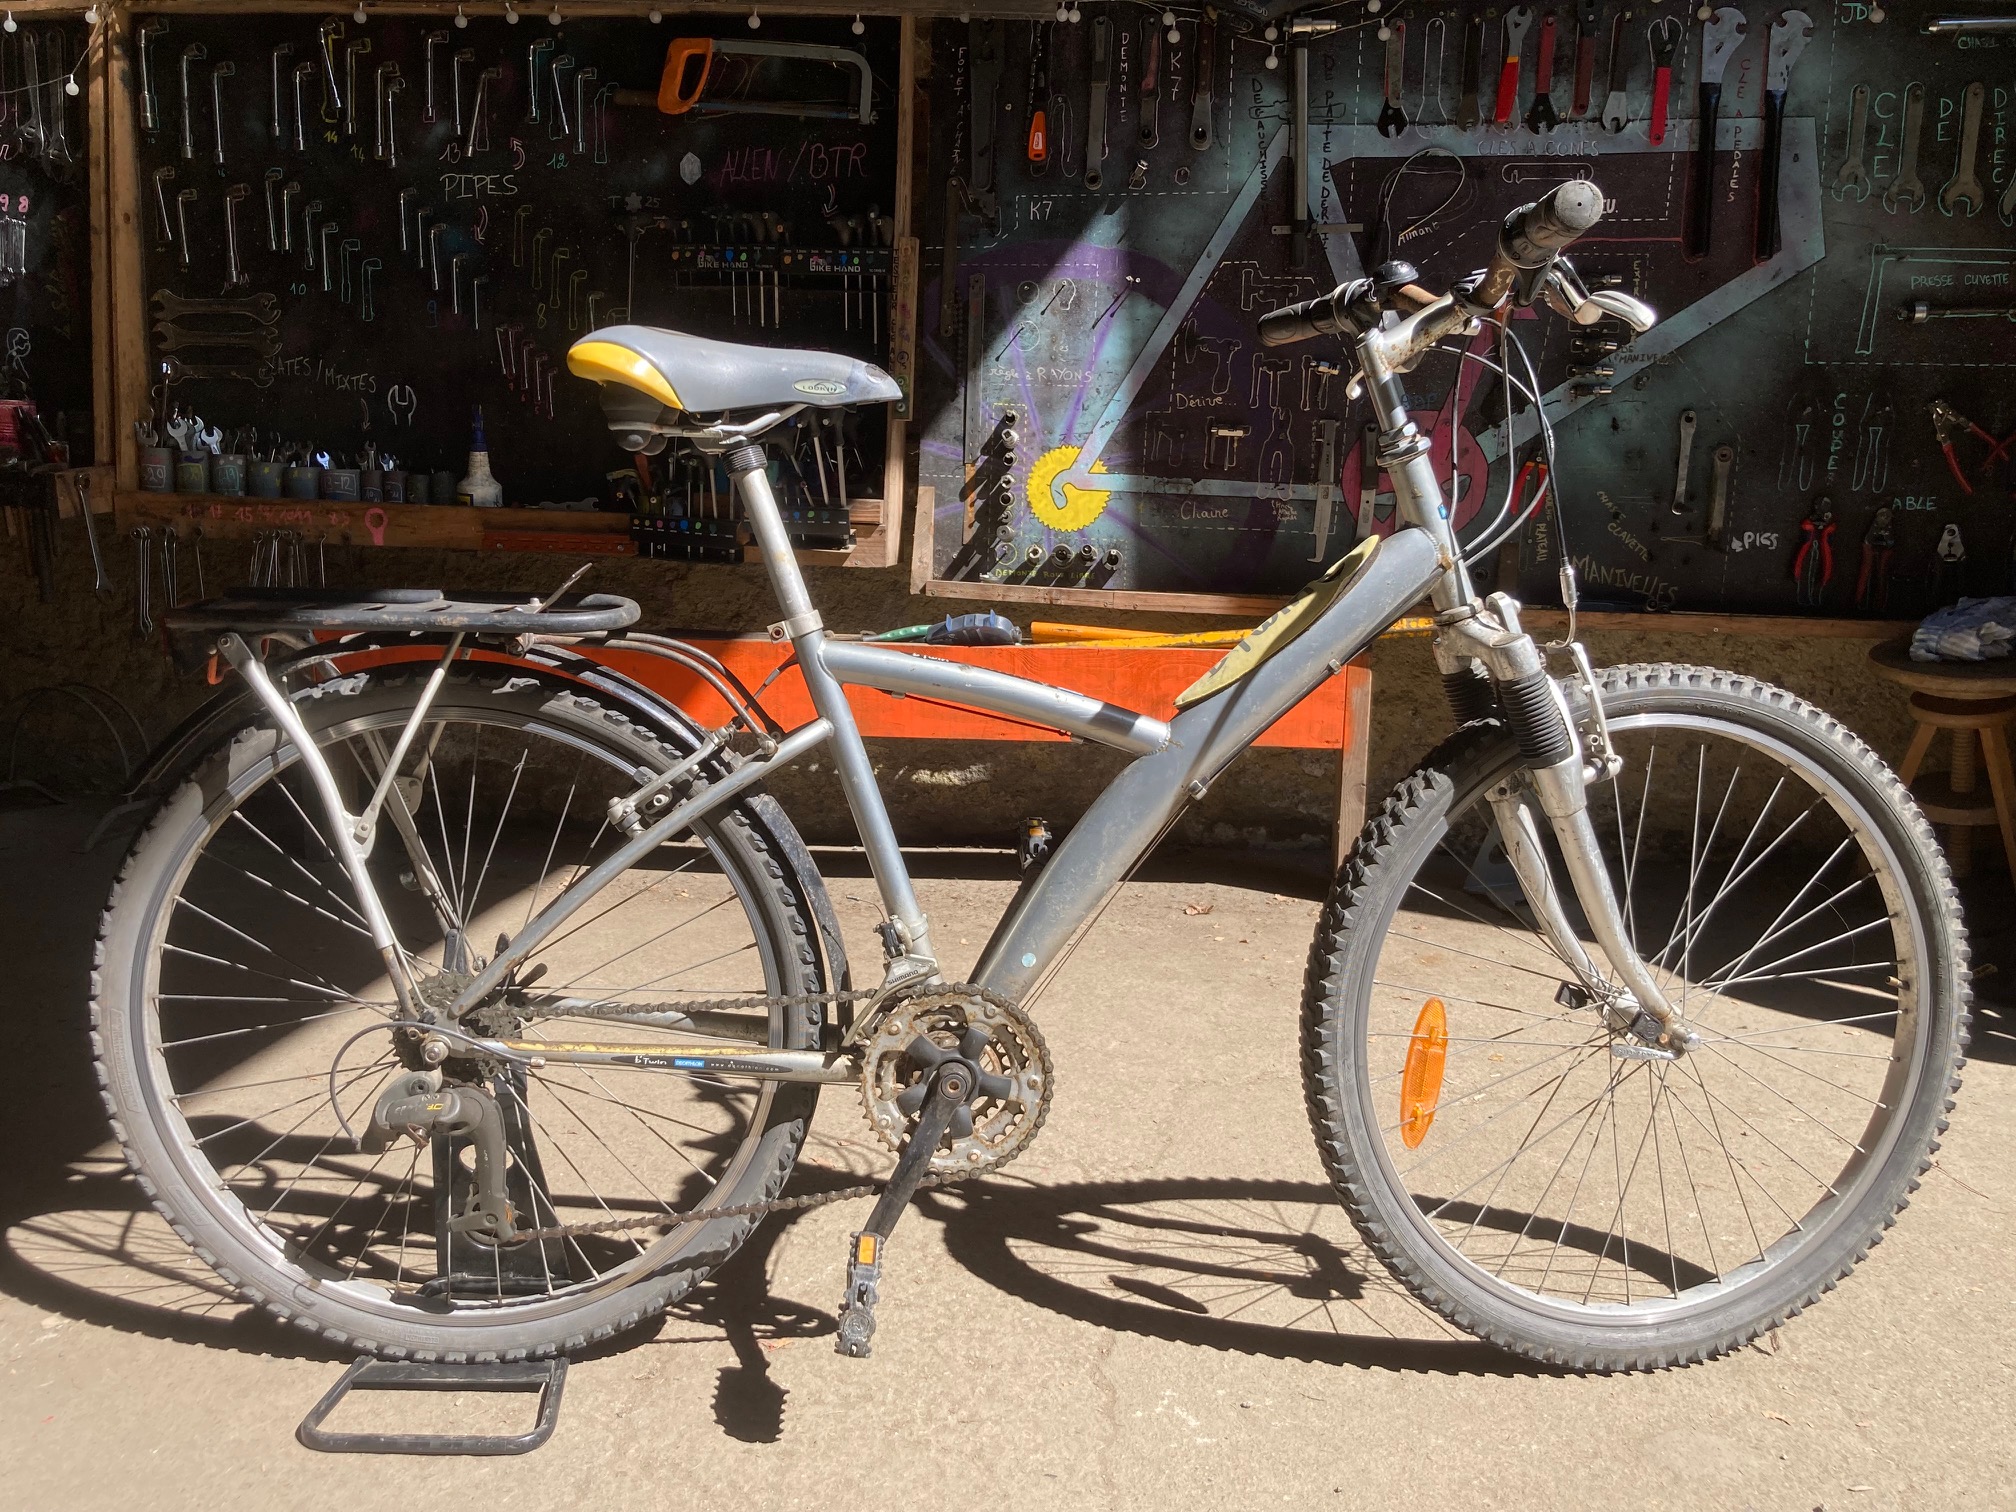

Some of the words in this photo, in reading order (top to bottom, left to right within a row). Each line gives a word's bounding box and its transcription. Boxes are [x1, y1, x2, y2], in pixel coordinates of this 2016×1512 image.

[1120, 32, 1130, 122] DEMONTE
[1323, 54, 1335, 82] DE
[1737, 58, 1751, 99] CLE
[1323, 91, 1335, 153] PATTE
[1735, 109, 1744, 118] A
[323, 130, 338, 143] 14
[1874, 92, 1897, 178] CLE
[1937, 98, 1953, 141] DE
[350, 143, 365, 162] 14
[439, 142, 461, 164] 13
[1477, 140, 1518, 156] CLES
[1528, 141, 1537, 157] A
[1545, 140, 1599, 157] CONES
[547, 153, 570, 169] 12
[1322, 157, 1331, 182] DE
[1726, 125, 1743, 202] PEDALES
[439, 174, 519, 202] PIPES
[1030, 200, 1053, 221] K7
[722, 261, 749, 269] HAND
[810, 257, 832, 272] BIKE
[834, 265, 861, 273] HAND
[290, 283, 307, 296] 10
[1911, 275, 1954, 290] PRESSE
[1964, 273, 2009, 287] CUVETTE
[537, 302, 547, 329] 8
[1037, 366, 1092, 383] RAYONS
[1571, 554, 1679, 602] MANIVELLES
[887, 969, 919, 986] SHIMANO
